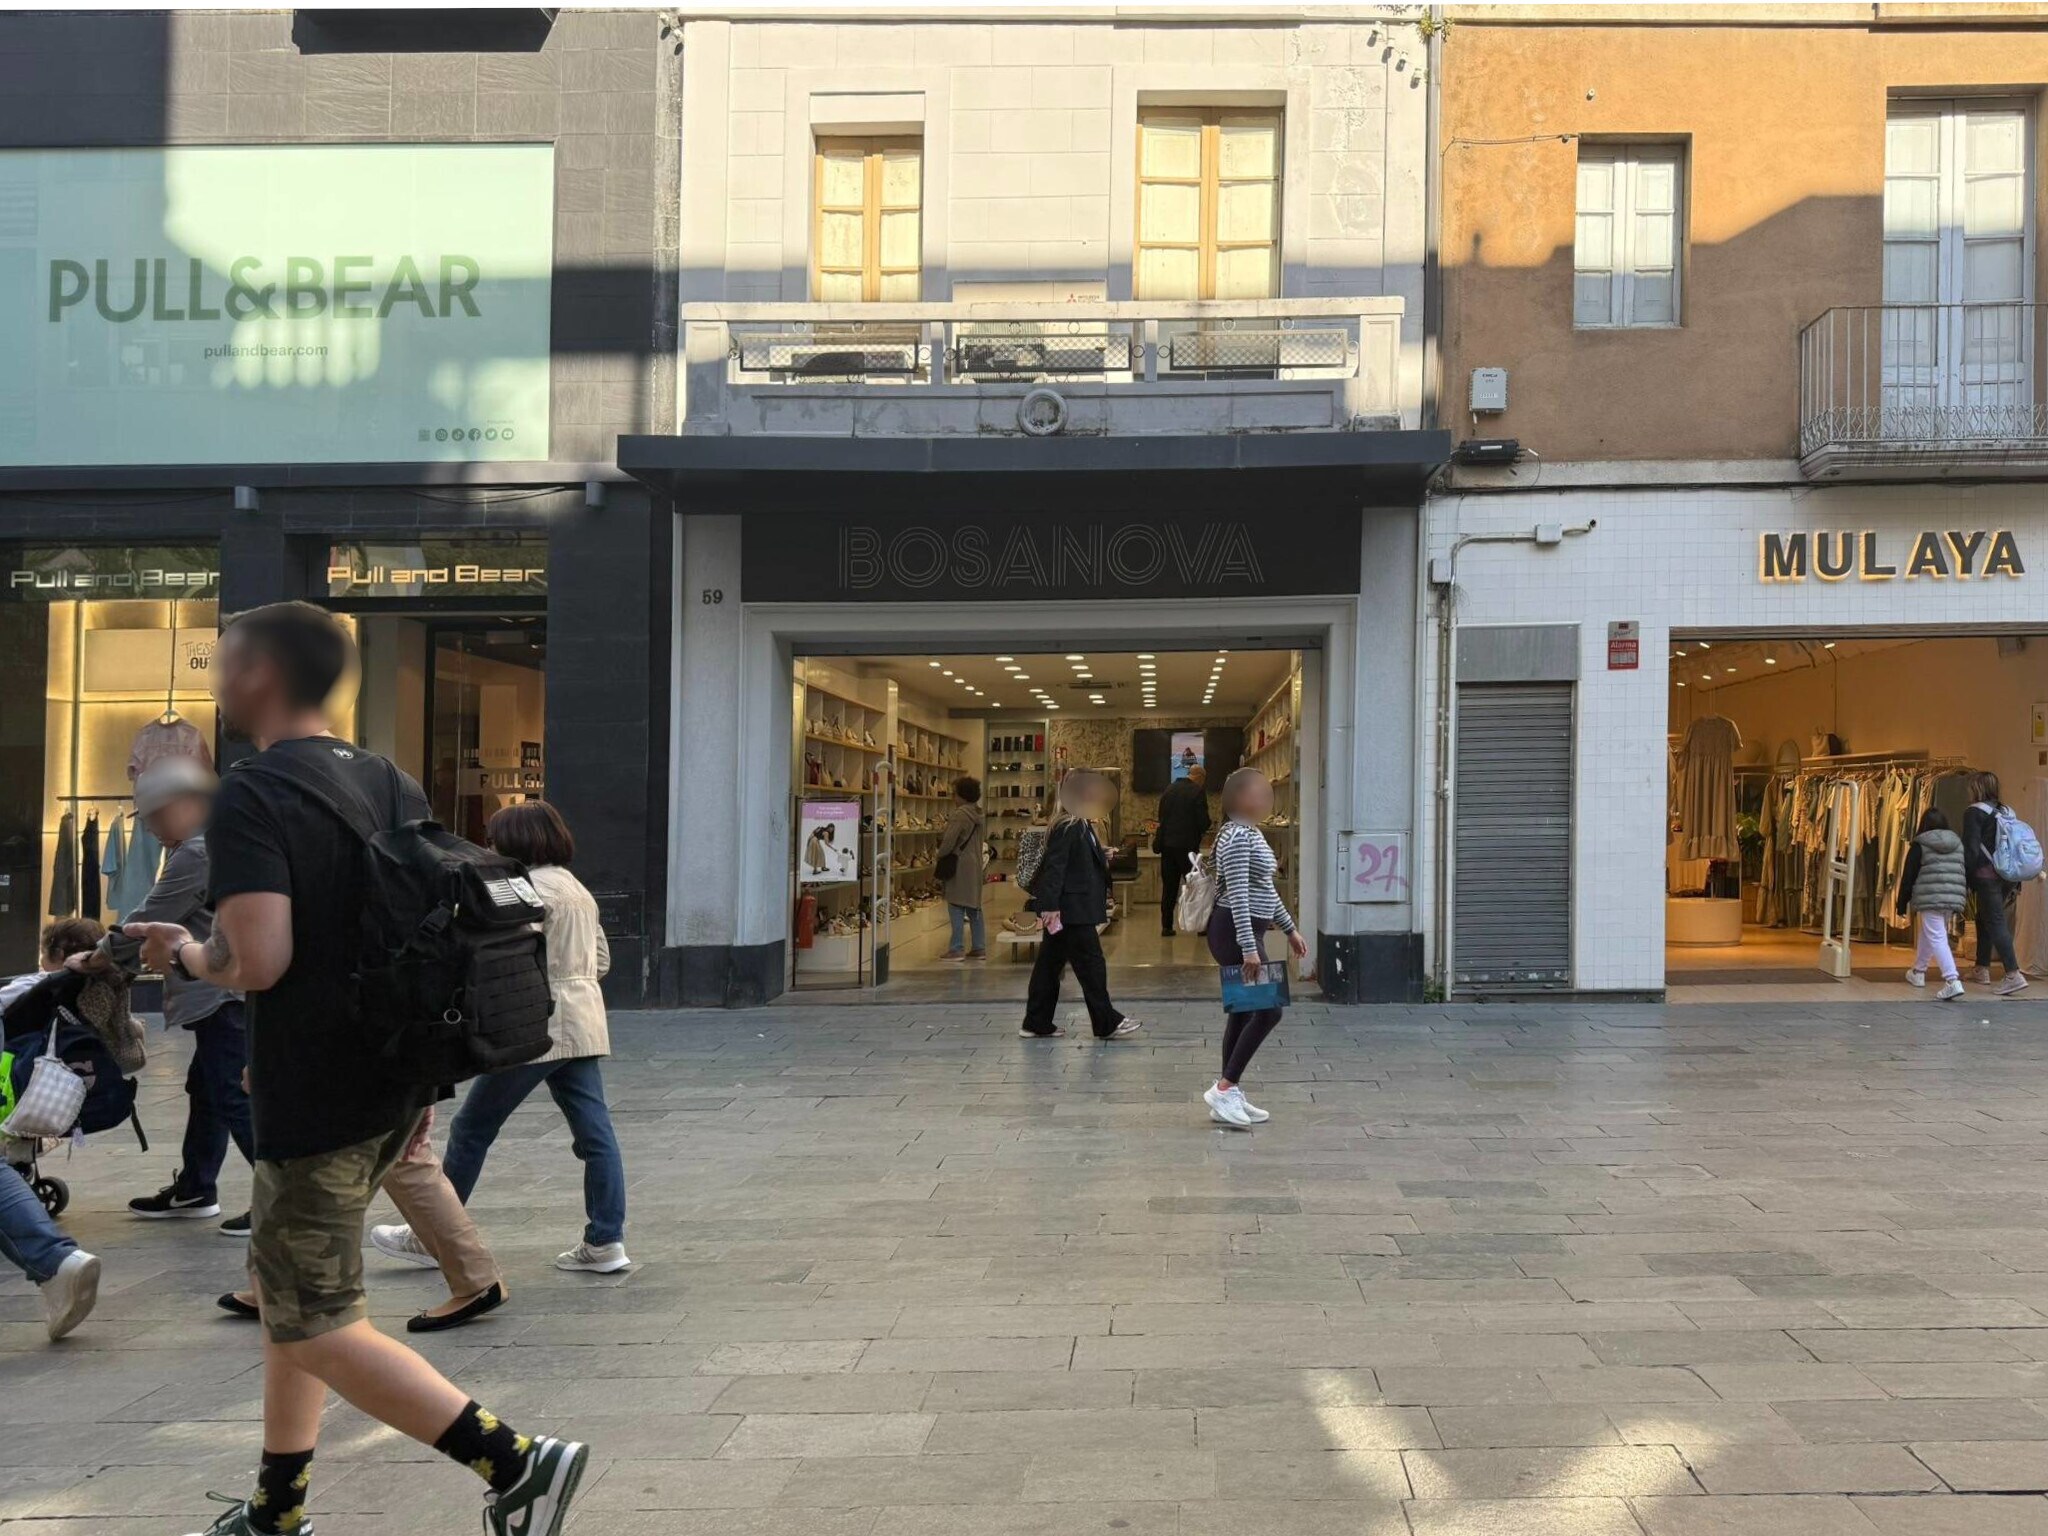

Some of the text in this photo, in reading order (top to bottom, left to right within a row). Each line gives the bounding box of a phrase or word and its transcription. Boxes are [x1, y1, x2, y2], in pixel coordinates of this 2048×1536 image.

[49, 255, 482, 322] PULL&BEAR
[204, 344, 328, 359] pullandbear.com
[838, 524, 1266, 589] BOSANOVA
[10, 569, 220, 588] Pull and Bear
[327, 565, 544, 584] Pull and Bear
[702, 589, 723, 605] 59
[190, 656, 210, 670] OU
